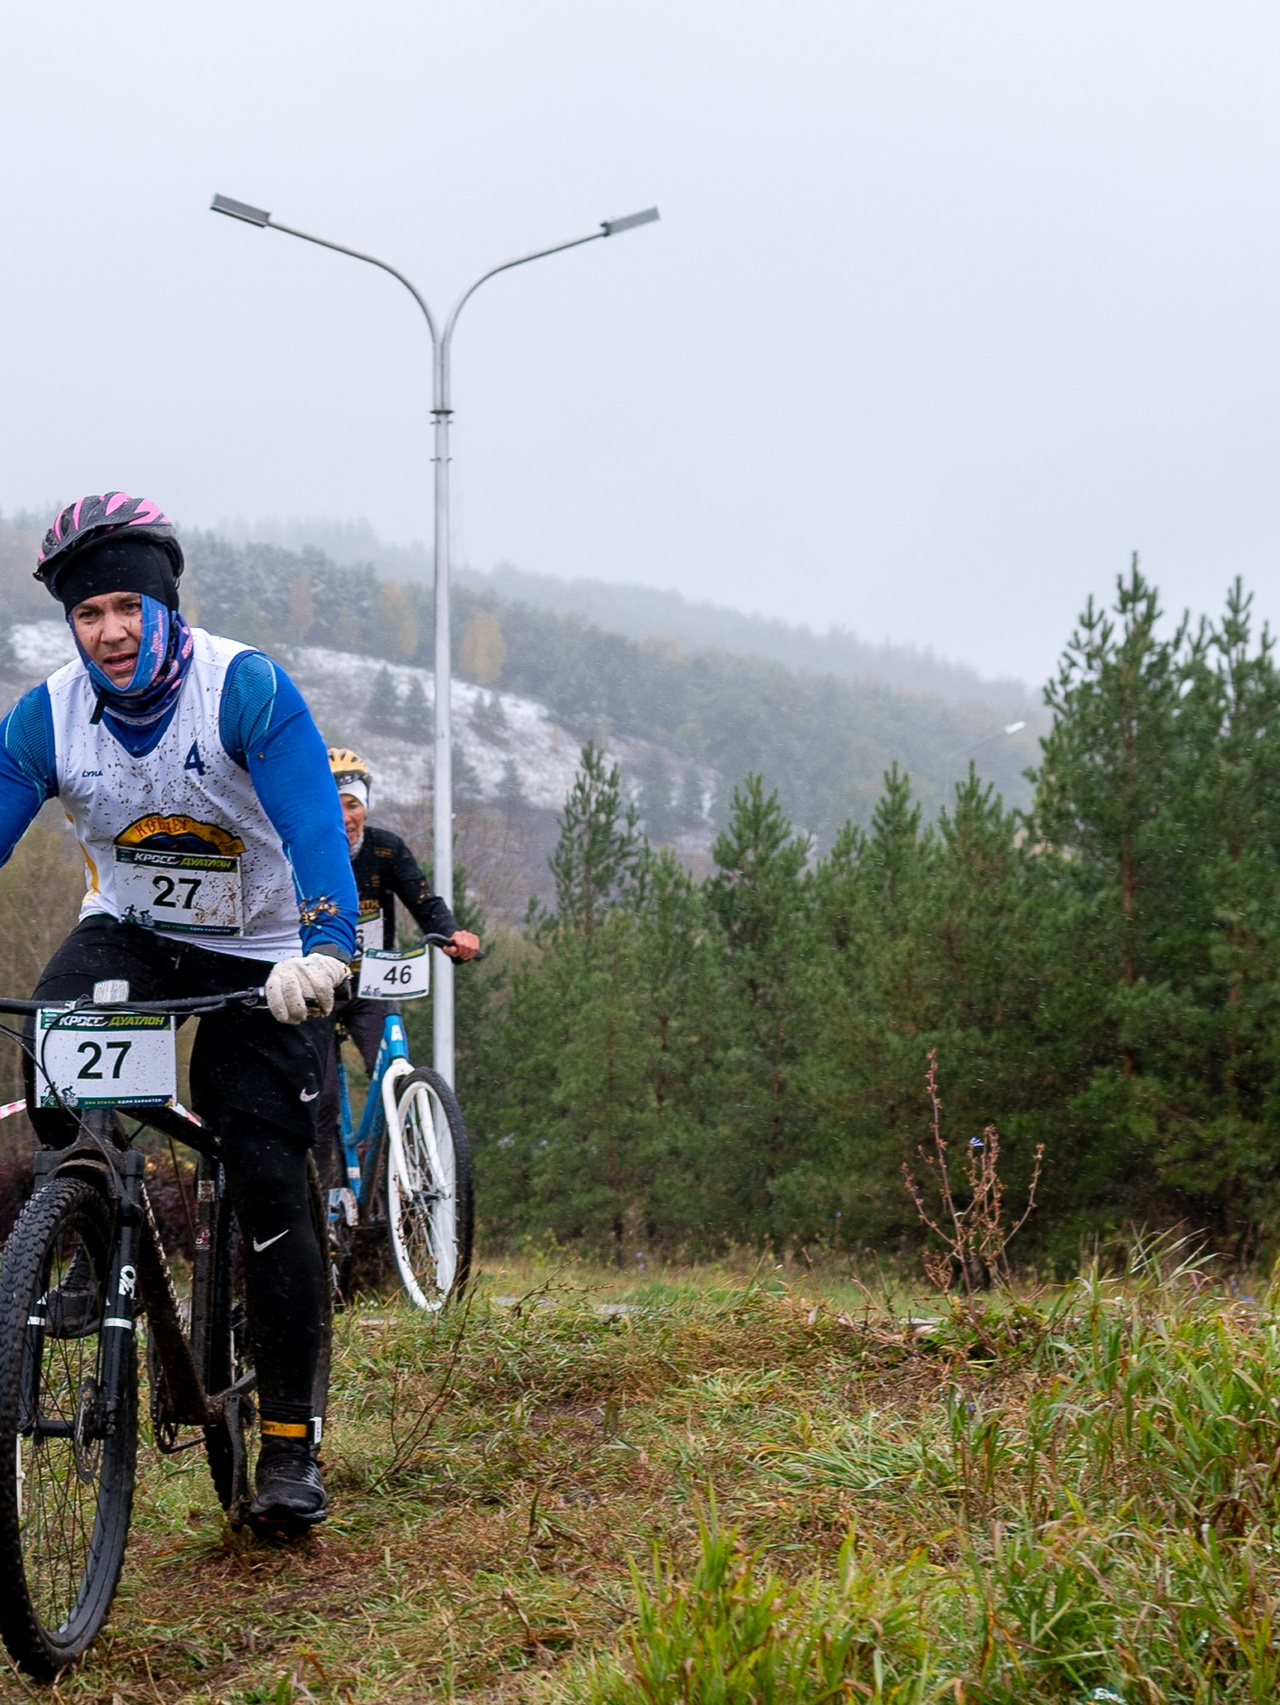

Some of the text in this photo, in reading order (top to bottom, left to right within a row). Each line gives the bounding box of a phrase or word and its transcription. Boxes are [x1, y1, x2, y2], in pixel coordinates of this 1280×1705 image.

[133, 852, 179, 865] КРОСС
[152, 875, 202, 910] 27
[383, 965, 412, 985] 46
[59, 1015, 107, 1027] КРОСС
[108, 1016, 166, 1028] ДУАТЛОН
[76, 1041, 133, 1080] 27
